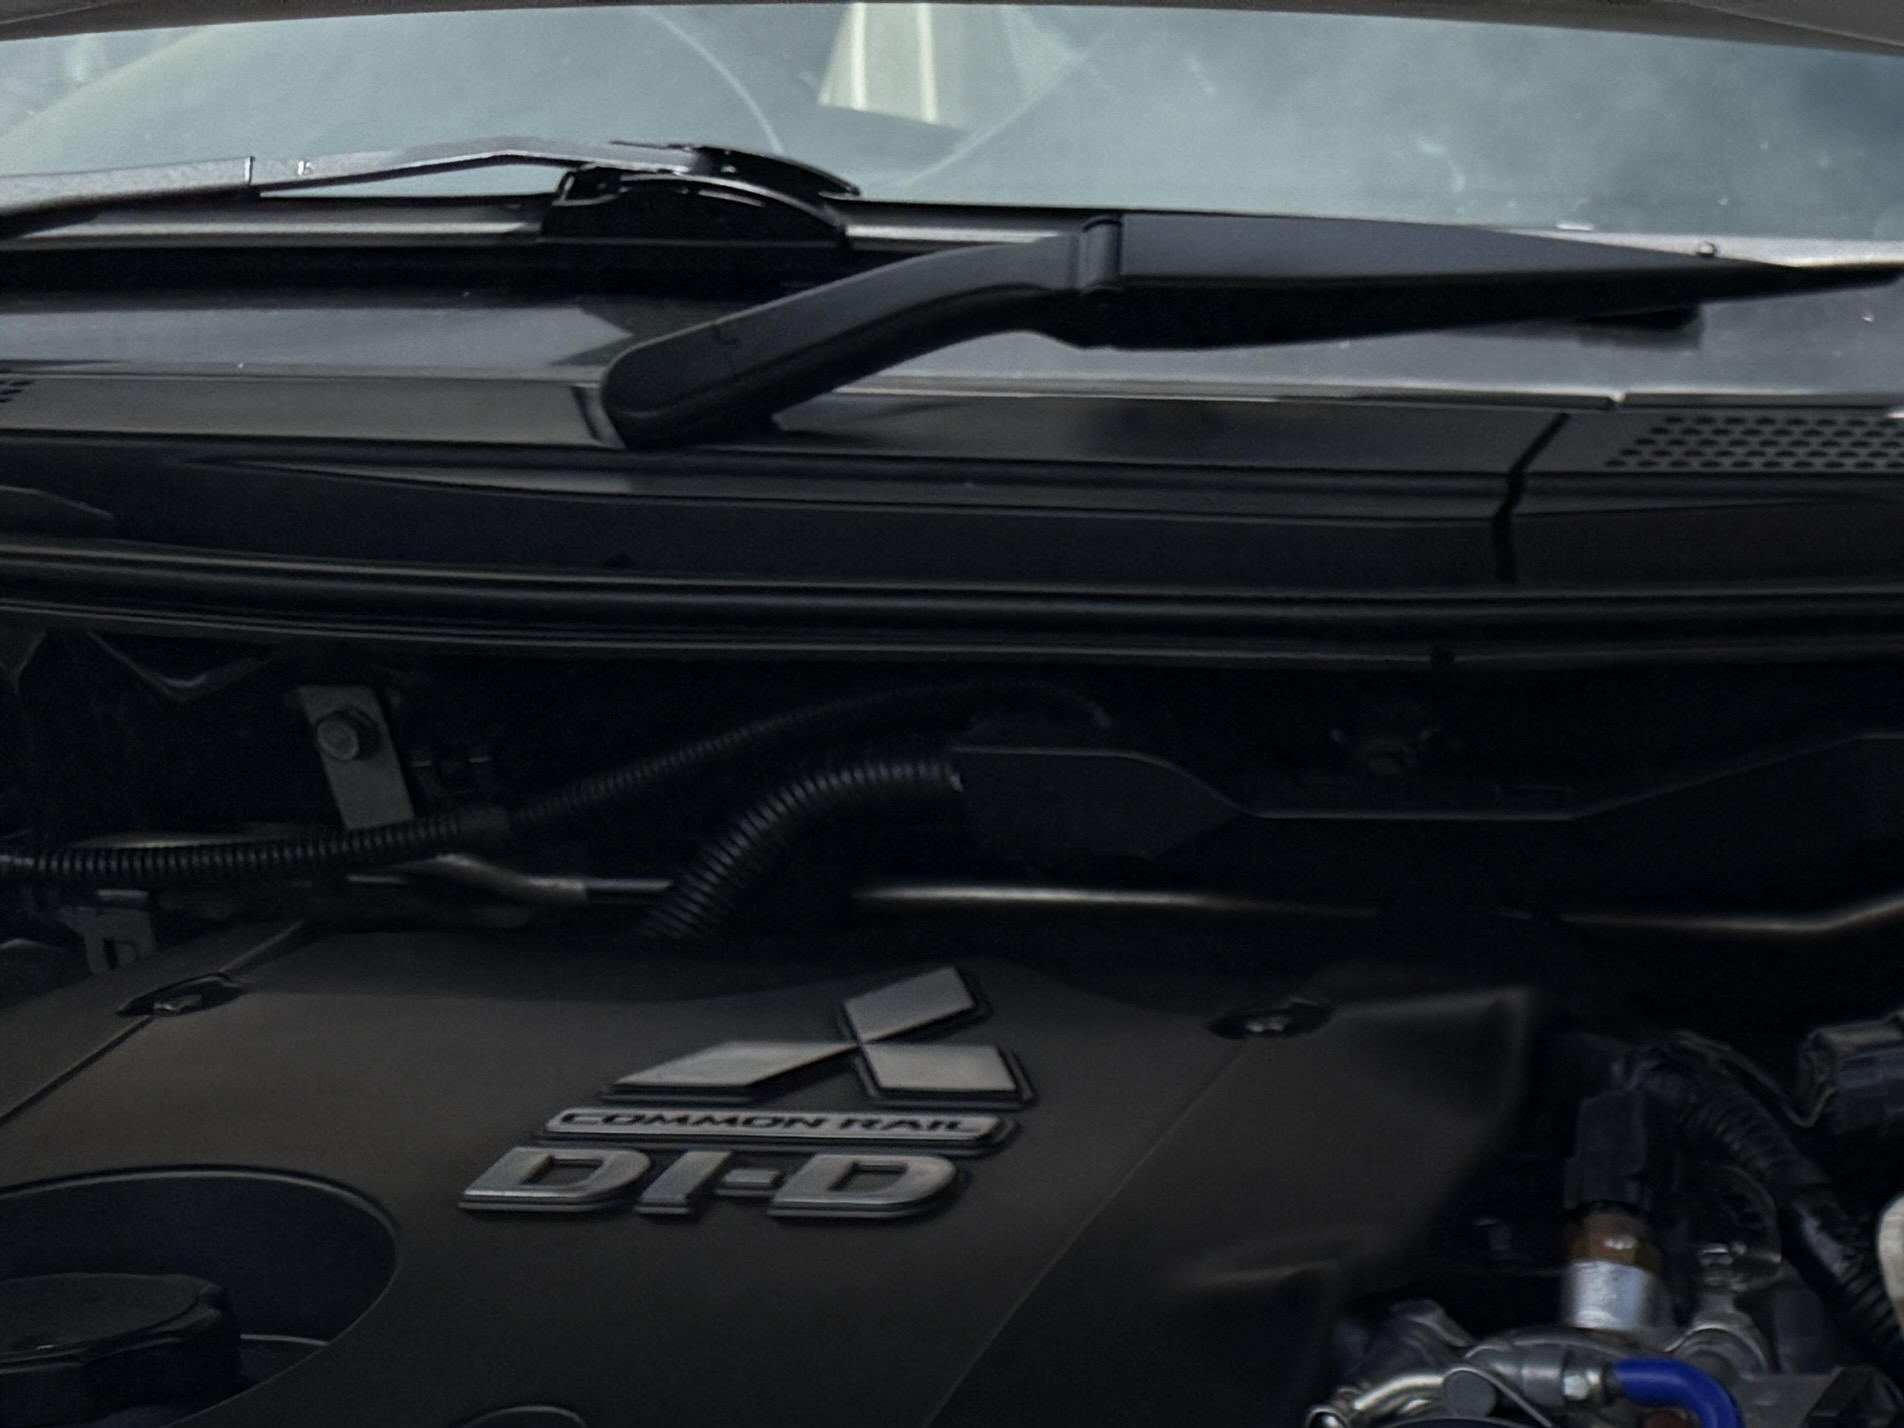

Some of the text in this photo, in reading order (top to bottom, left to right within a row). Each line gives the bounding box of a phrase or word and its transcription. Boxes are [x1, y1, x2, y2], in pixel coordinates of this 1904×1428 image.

[559, 1111, 985, 1135] COMMON RAIL
[457, 1145, 958, 1218] DI-D
